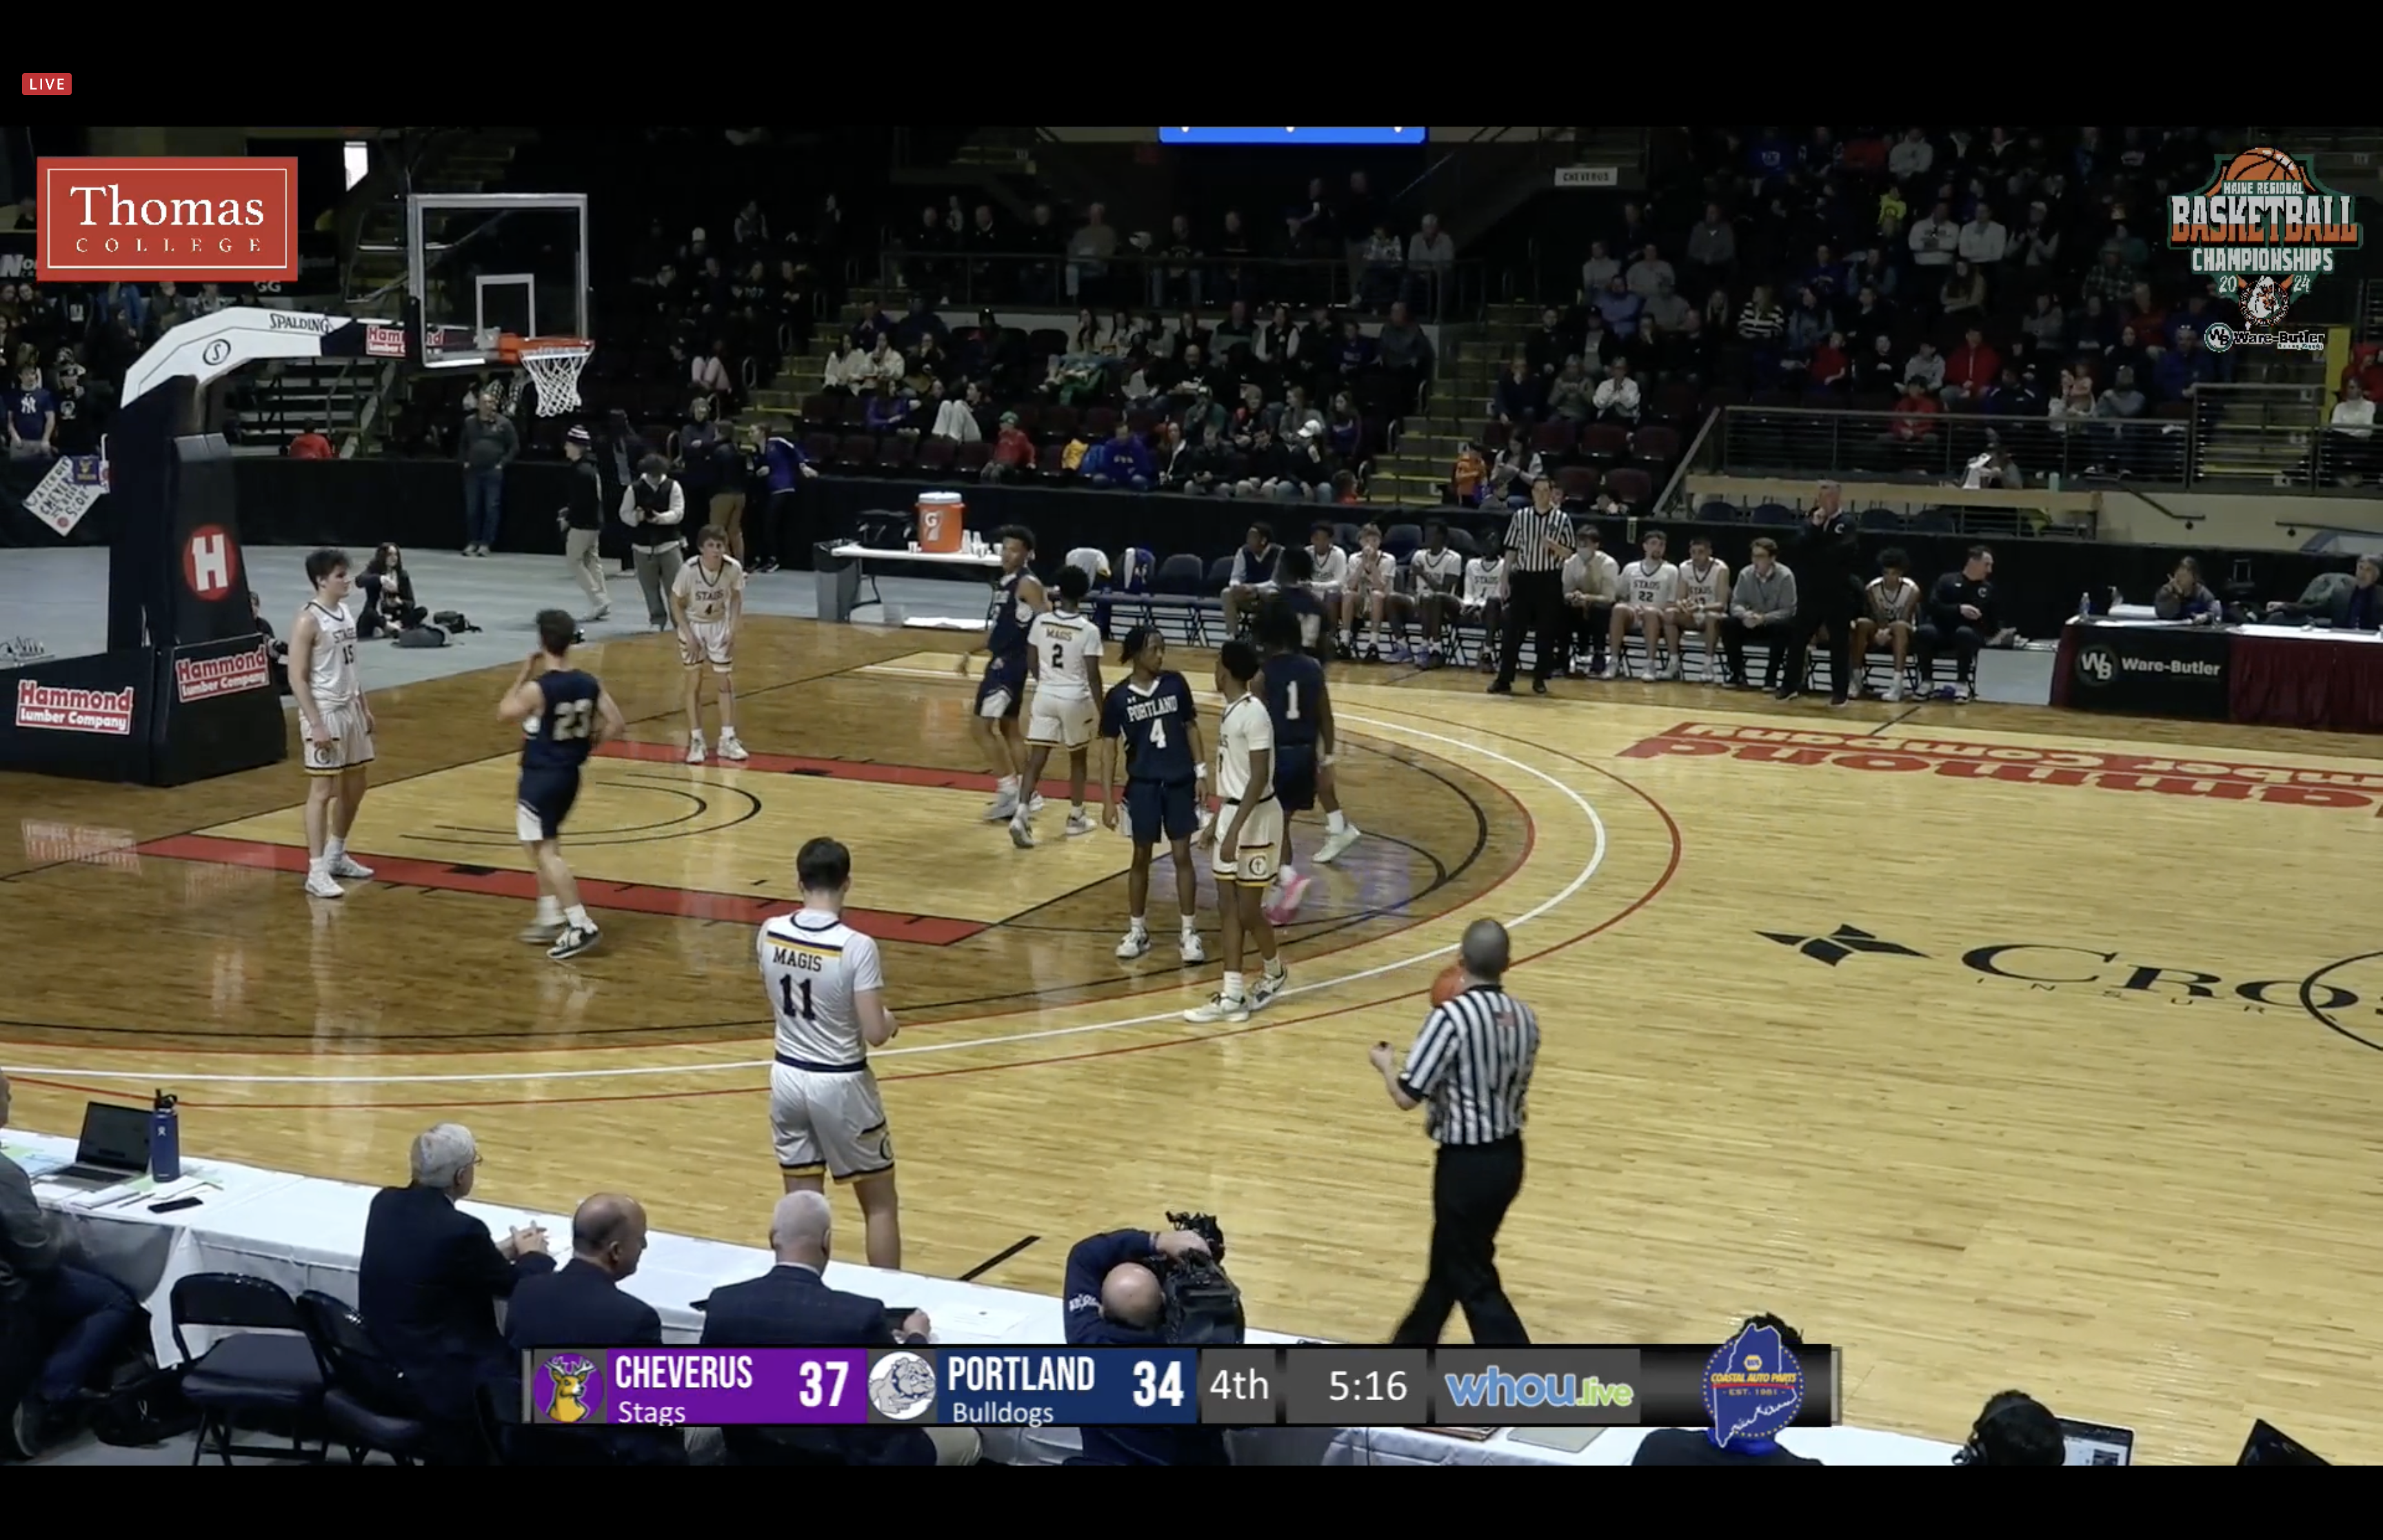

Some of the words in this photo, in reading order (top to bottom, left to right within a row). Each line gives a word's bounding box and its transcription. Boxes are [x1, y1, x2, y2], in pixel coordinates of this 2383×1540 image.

[270, 313, 330, 334] SPALDING
[192, 534, 228, 591] H
[1638, 591, 1654, 602] 22
[177, 646, 266, 682] Hammond
[342, 645, 354, 665] 15
[1052, 644, 1063, 669] 2
[2121, 657, 2221, 676] Ware-Butler
[19, 680, 132, 711] Hammond
[181, 678, 219, 696] Lumber
[220, 671, 265, 689] Company
[1127, 695, 1178, 722] PORTLAND
[1286, 680, 1300, 720] 1
[20, 707, 65, 724] Lumber
[68, 711, 127, 731] Company
[553, 699, 593, 741] 23
[1149, 719, 1167, 749] 4
[772, 946, 822, 973] MAGIS
[779, 973, 816, 1022] 11
